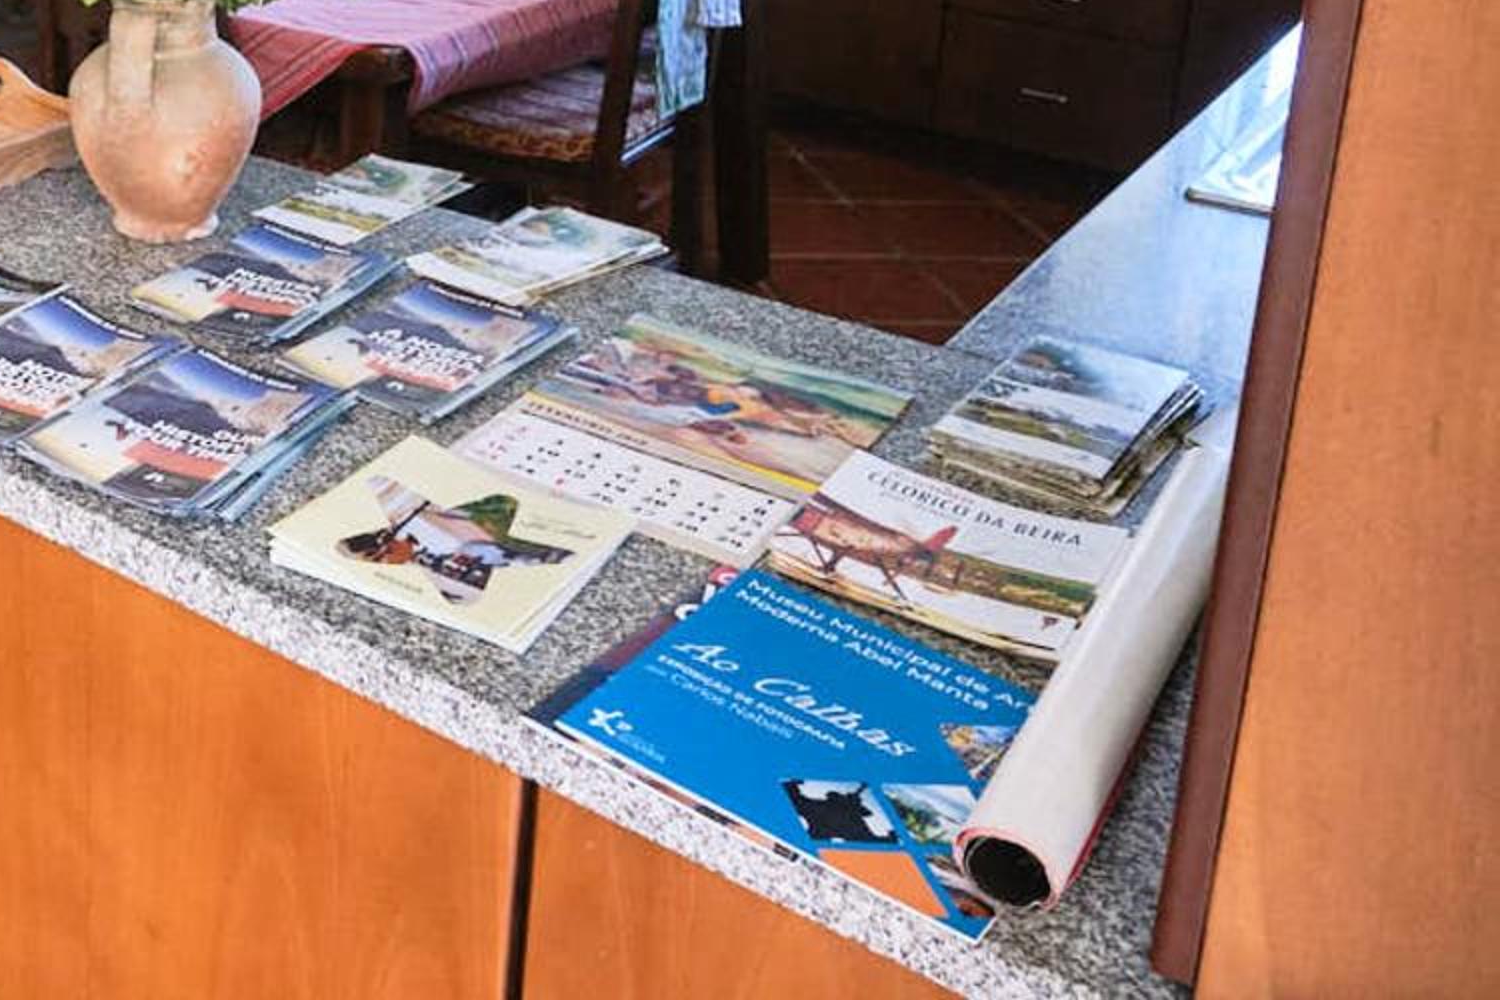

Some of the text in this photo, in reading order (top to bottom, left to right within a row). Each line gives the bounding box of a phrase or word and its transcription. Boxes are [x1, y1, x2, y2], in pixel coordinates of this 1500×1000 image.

[866, 468, 970, 518] CELORICO
[973, 509, 1006, 531] DA
[1012, 521, 1085, 548] BEIRA
[671, 643, 740, 673] Ao
[734, 588, 840, 644] Moderna
[843, 639, 902, 672] Abel
[747, 578, 825, 622] Museu
[829, 616, 953, 676] Municipal
[954, 671, 991, 695] de
